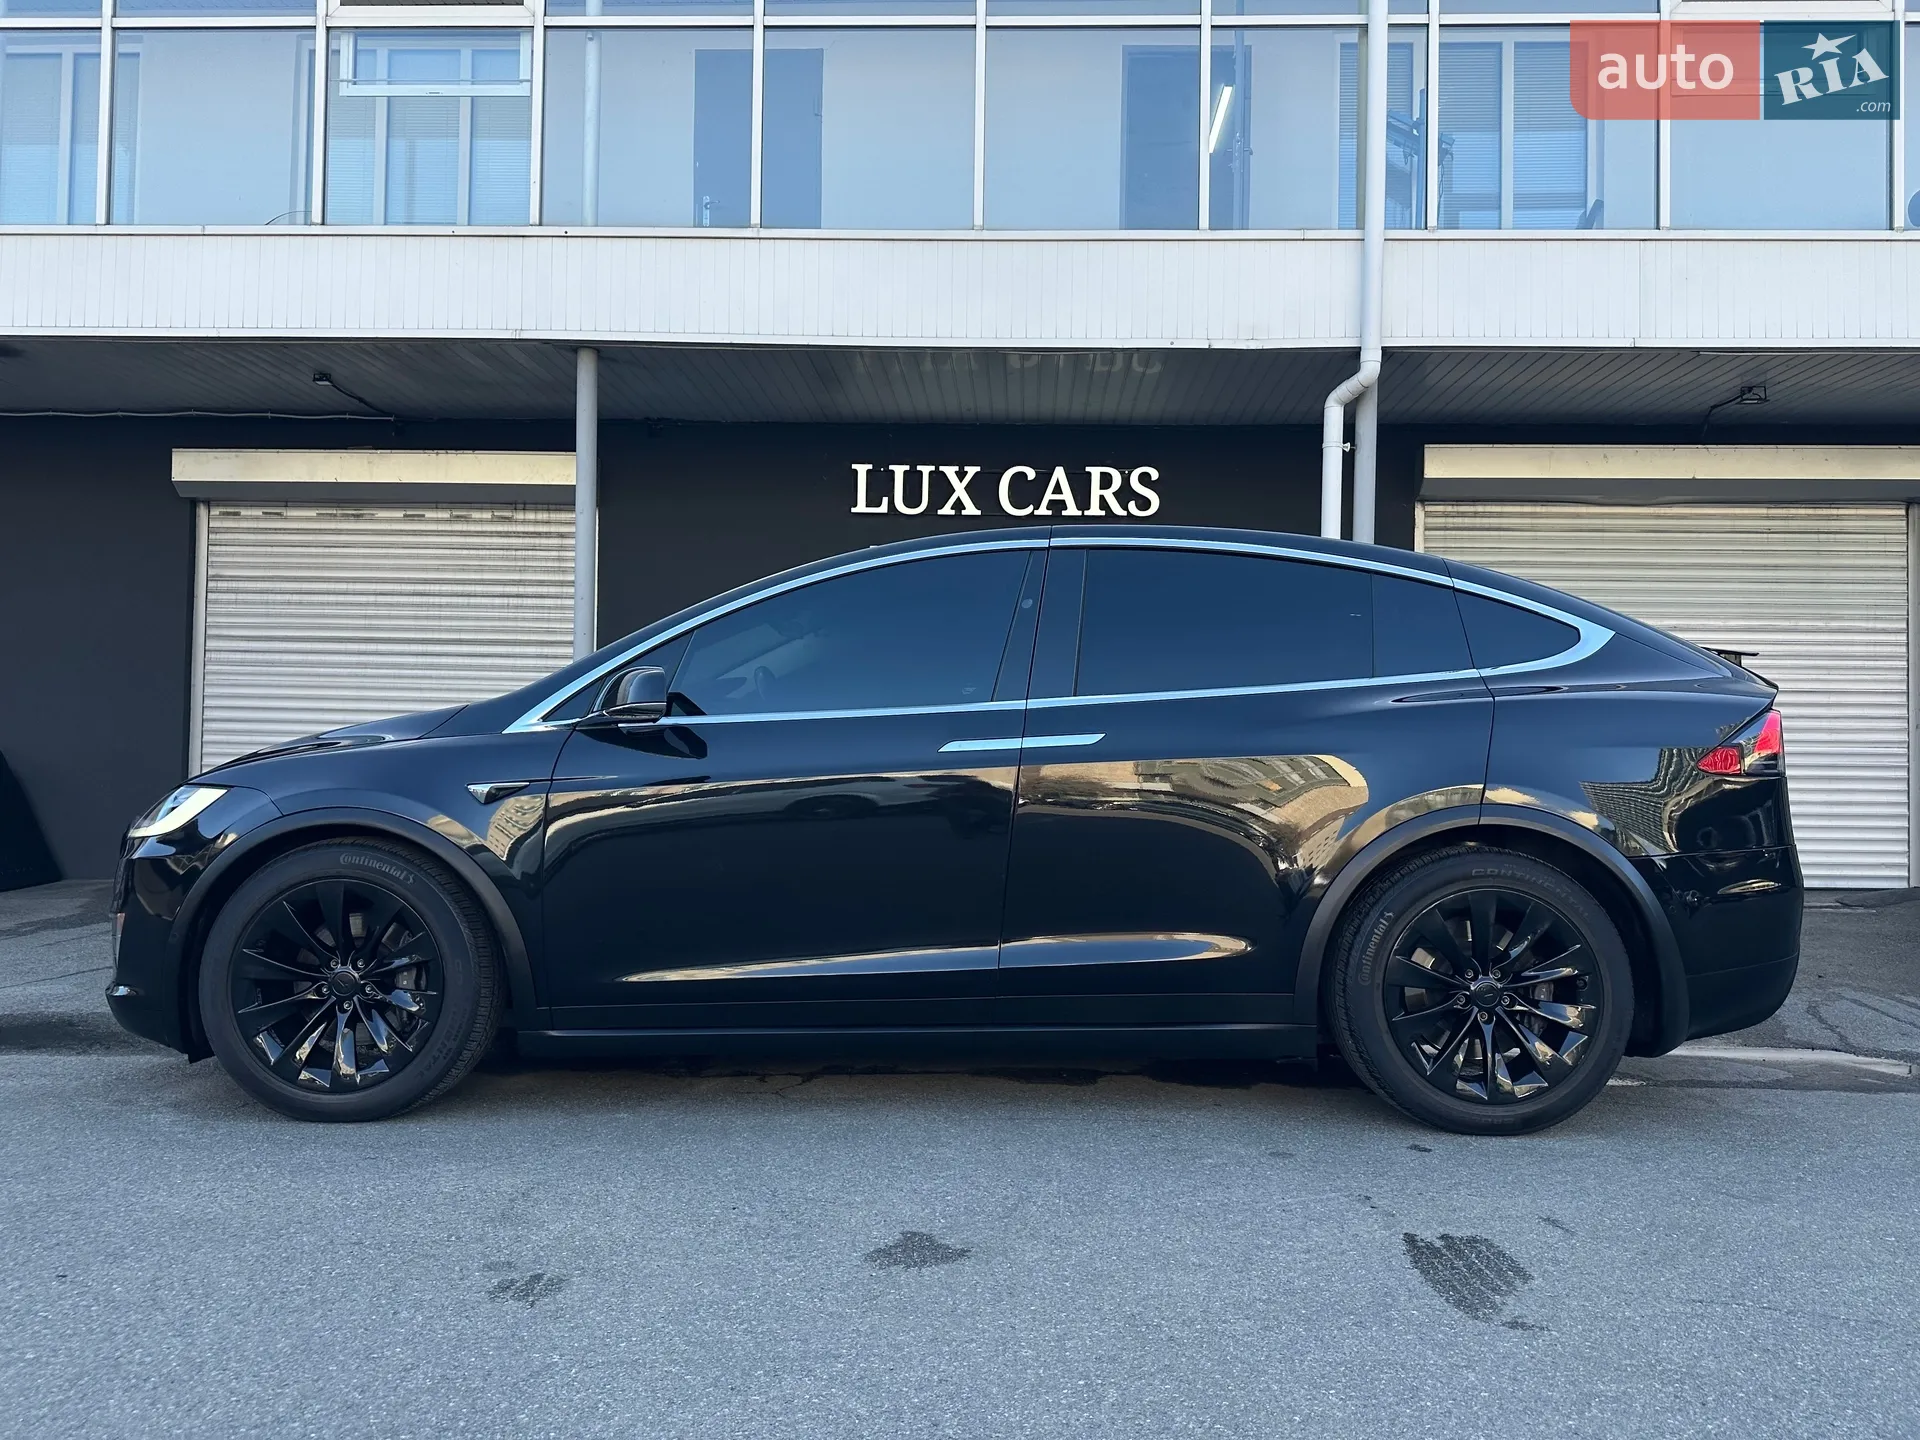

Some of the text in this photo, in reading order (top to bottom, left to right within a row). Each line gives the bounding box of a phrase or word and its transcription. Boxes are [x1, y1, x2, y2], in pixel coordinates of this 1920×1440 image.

[851, 463, 1160, 517] LUX CARS
[340, 852, 407, 880] Continental
[1358, 918, 1389, 985] Continental
